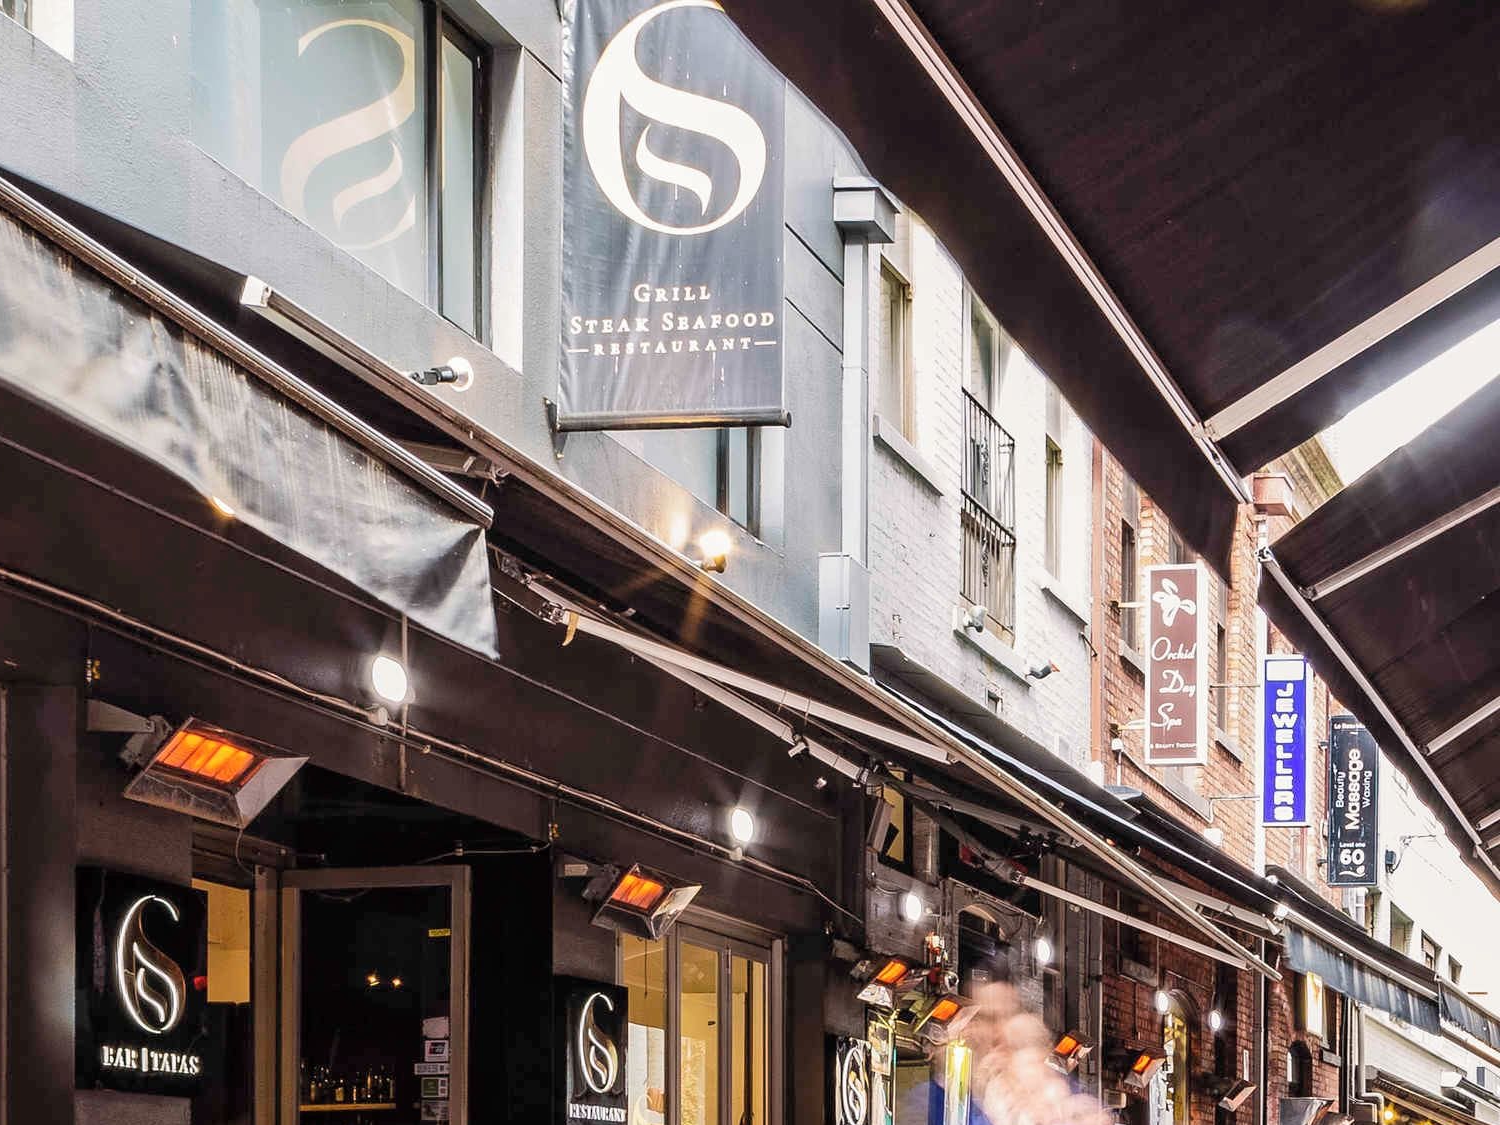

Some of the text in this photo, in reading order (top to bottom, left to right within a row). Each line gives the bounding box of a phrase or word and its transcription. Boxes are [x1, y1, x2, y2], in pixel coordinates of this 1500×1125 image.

[634, 283, 711, 302] GRILL
[570, 311, 774, 335] STEAK SEAFOOD
[593, 337, 751, 355] RESTAURANT
[1151, 636, 1197, 661] Orchid
[1159, 669, 1196, 697] Day
[1150, 702, 1182, 732] Spa
[1336, 771, 1346, 808] Beauty
[1345, 749, 1364, 830] Massage
[1362, 770, 1373, 808] Waxing
[1339, 848, 1365, 866] 60
[102, 1045, 200, 1076] BAR TAPAS
